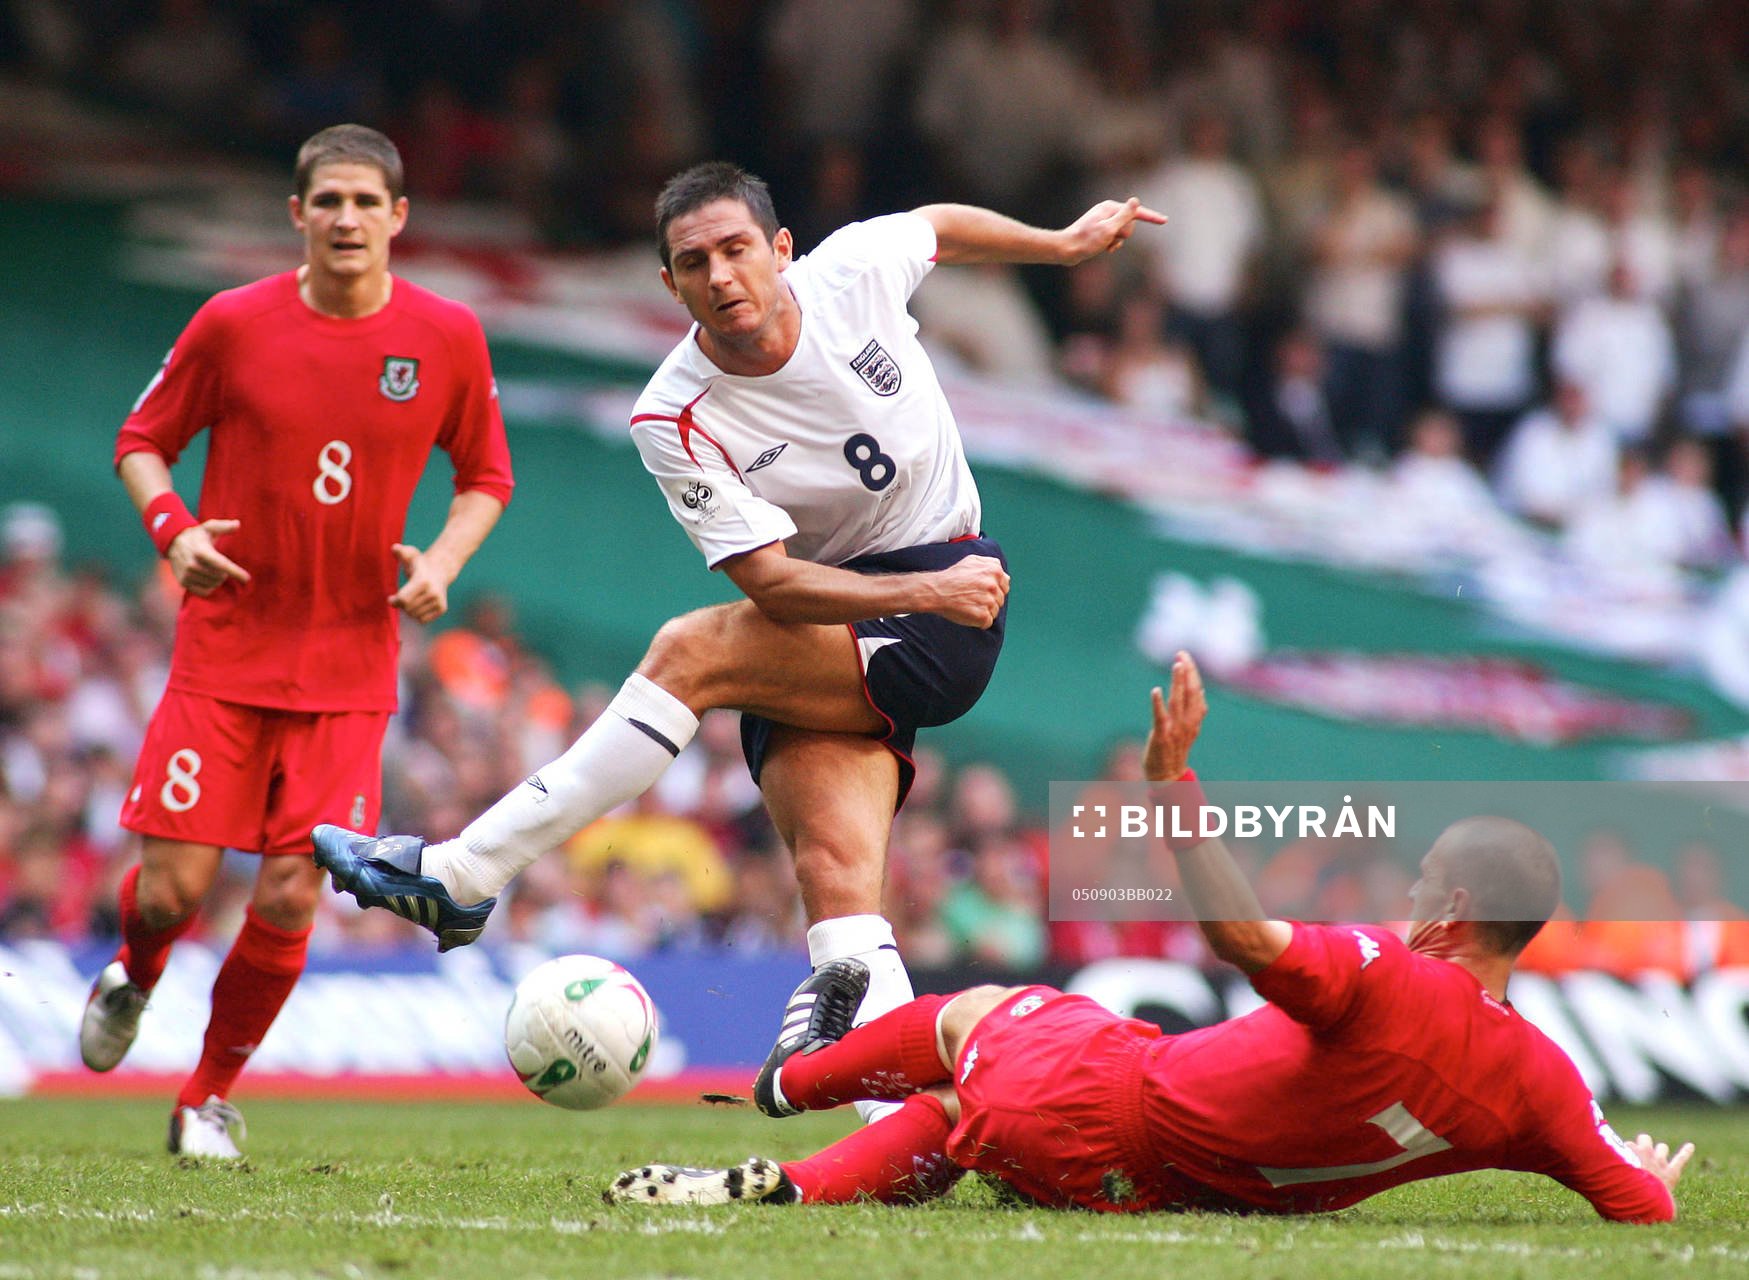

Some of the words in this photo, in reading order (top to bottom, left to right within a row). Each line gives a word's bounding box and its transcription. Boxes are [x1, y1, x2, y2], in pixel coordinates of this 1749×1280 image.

[850, 340, 878, 369] ENGLAND
[313, 440, 352, 505] 8
[844, 433, 896, 491] 8
[161, 748, 202, 812] 8
[564, 1028, 607, 1073] mitre
